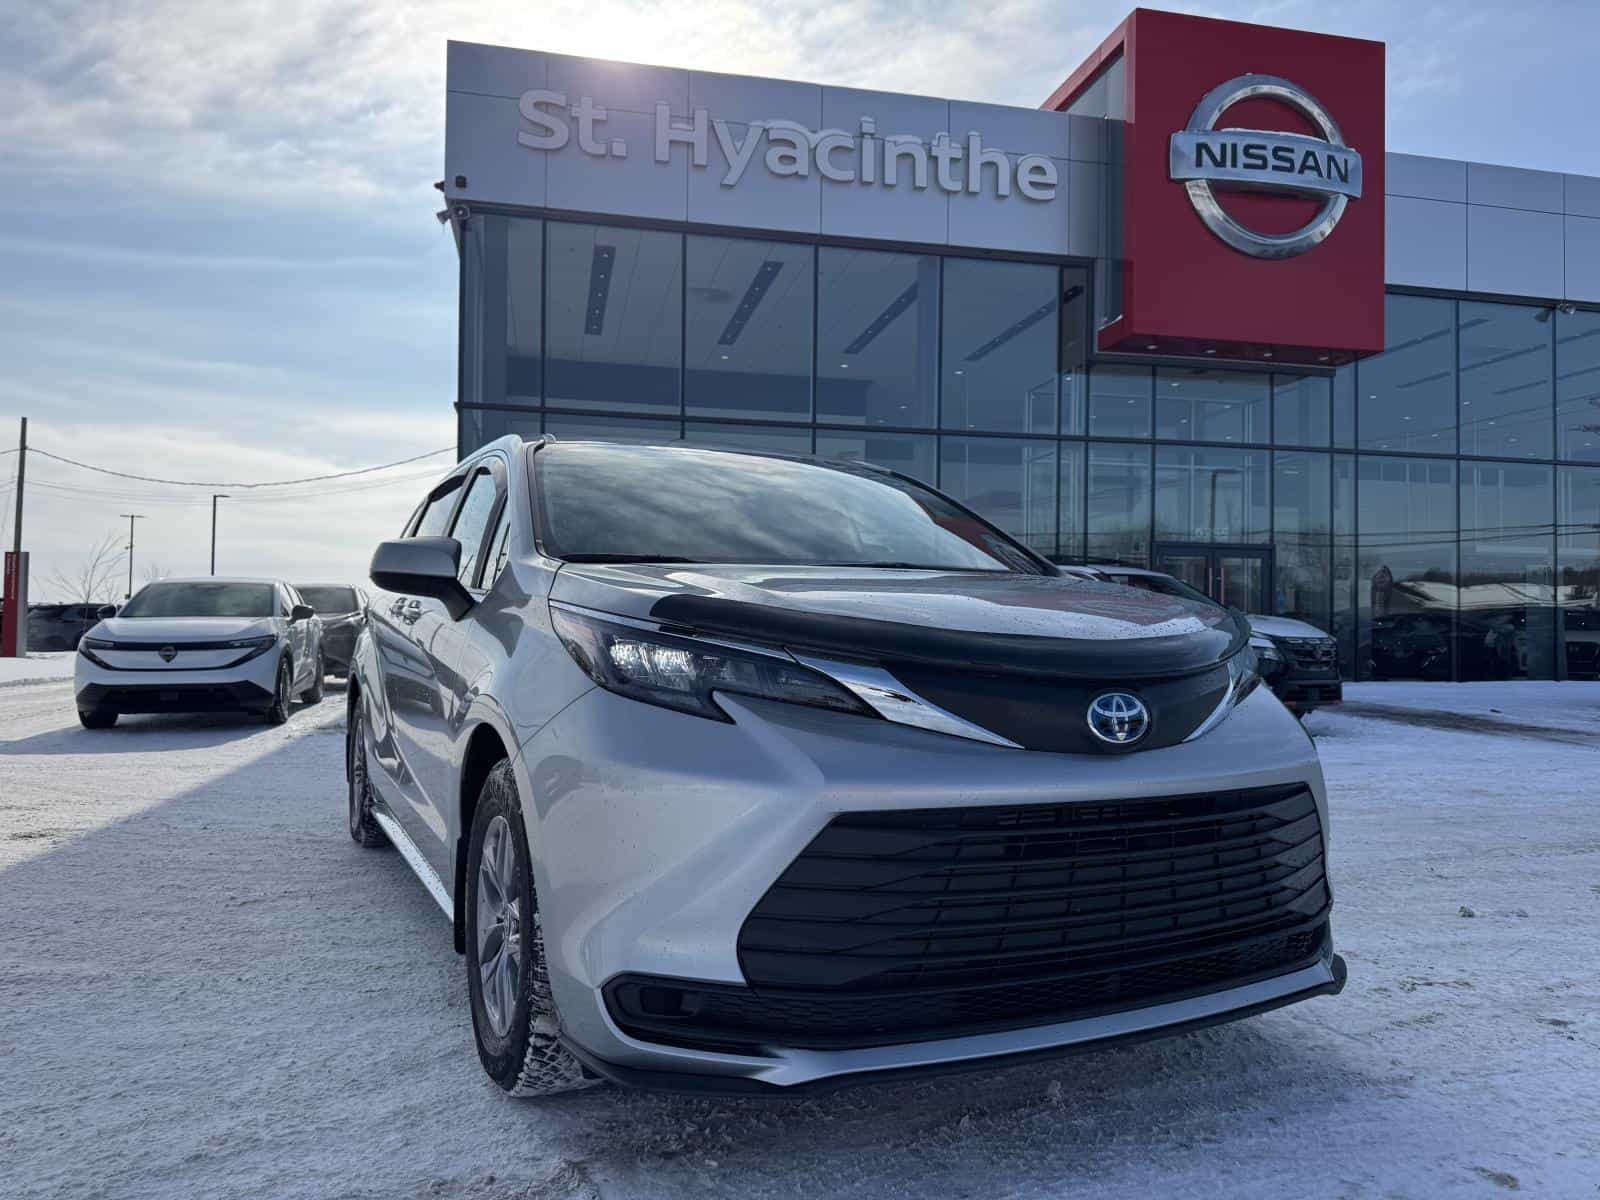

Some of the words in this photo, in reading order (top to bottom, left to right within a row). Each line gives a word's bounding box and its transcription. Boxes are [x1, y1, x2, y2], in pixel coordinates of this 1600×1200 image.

[517, 88, 628, 158] St.
[654, 99, 1059, 202] Hyacinthe
[1194, 142, 1350, 184] NISSAN
